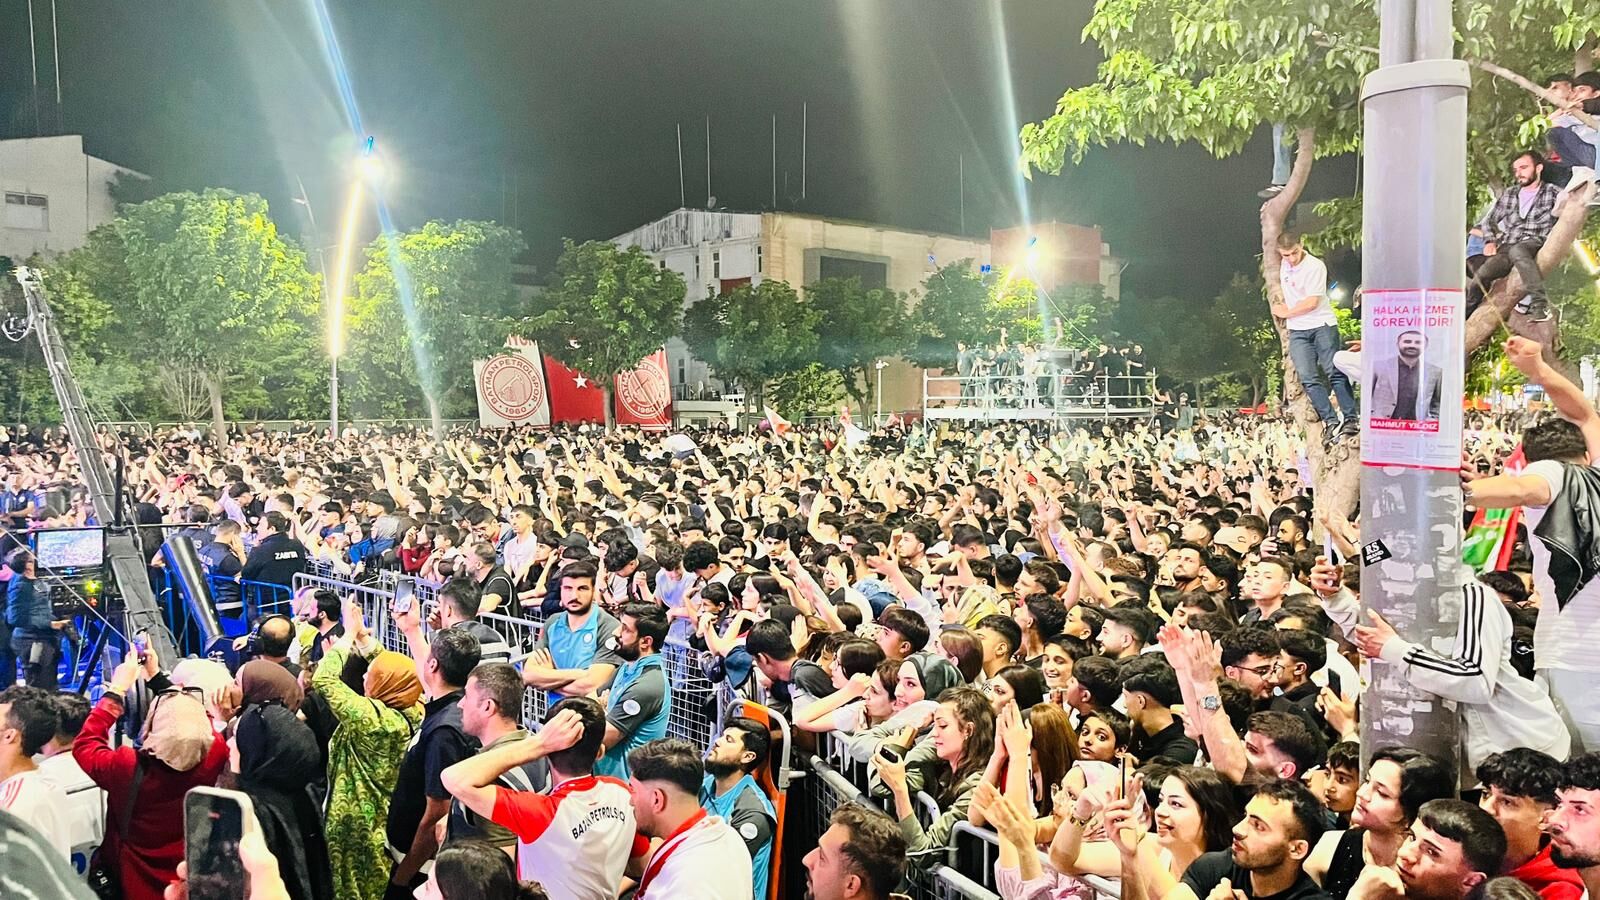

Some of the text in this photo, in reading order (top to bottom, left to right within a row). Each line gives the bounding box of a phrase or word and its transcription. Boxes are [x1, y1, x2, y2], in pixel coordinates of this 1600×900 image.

[1373, 305, 1455, 314] HALKA HZMET
[504, 406, 527, 415] 1960
[1371, 420, 1438, 431] MAHMUT YILDIZ
[1365, 541, 1380, 556] RS
